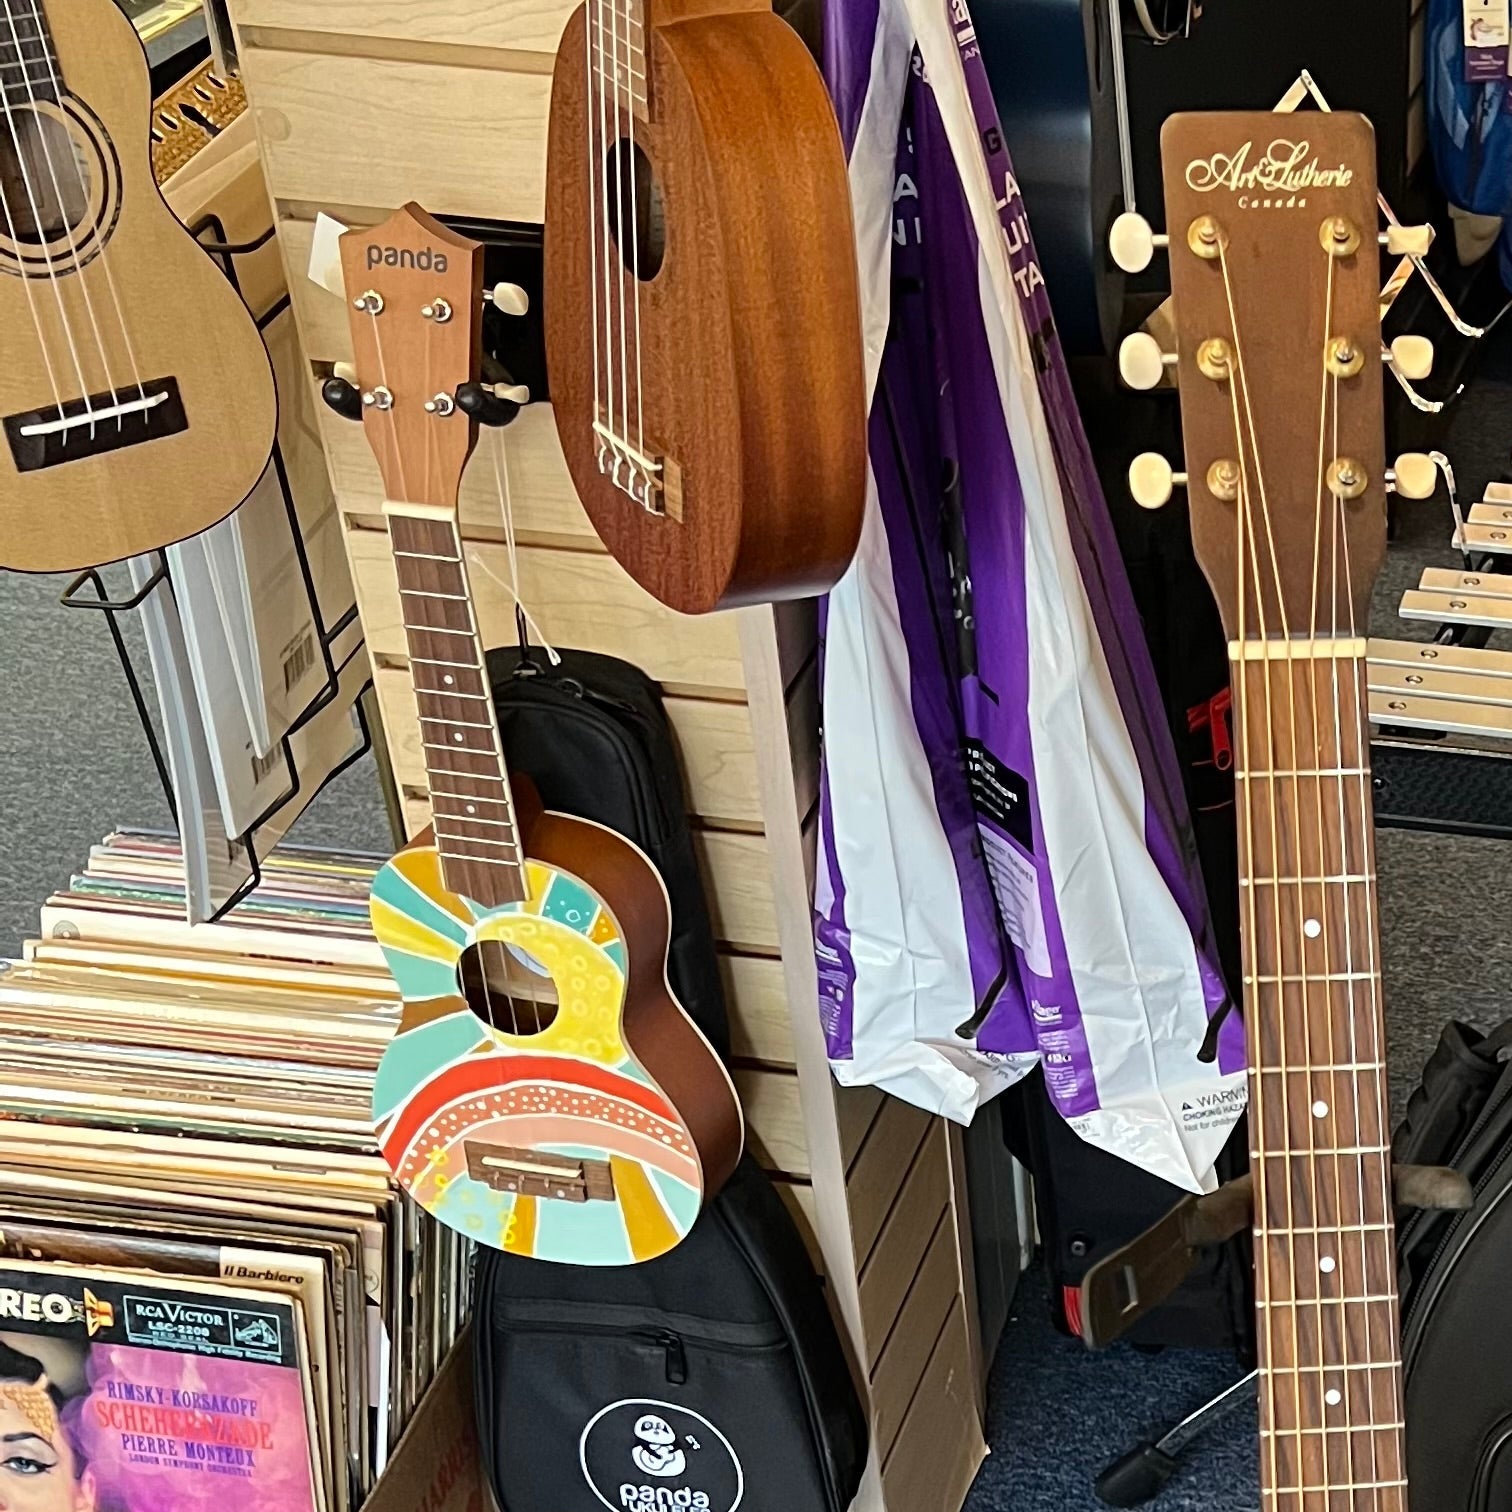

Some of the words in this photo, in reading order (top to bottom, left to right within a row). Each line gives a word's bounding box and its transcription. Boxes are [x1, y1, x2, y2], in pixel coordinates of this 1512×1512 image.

[1238, 196, 1307, 209] Canada
[367, 244, 448, 273] panda
[136, 1304, 165, 1318] RCA
[161, 1303, 223, 1326] VICTOR
[121, 1433, 178, 1456] PIERRE
[185, 1442, 256, 1467] MONTEUX
[619, 1483, 710, 1507] panda
